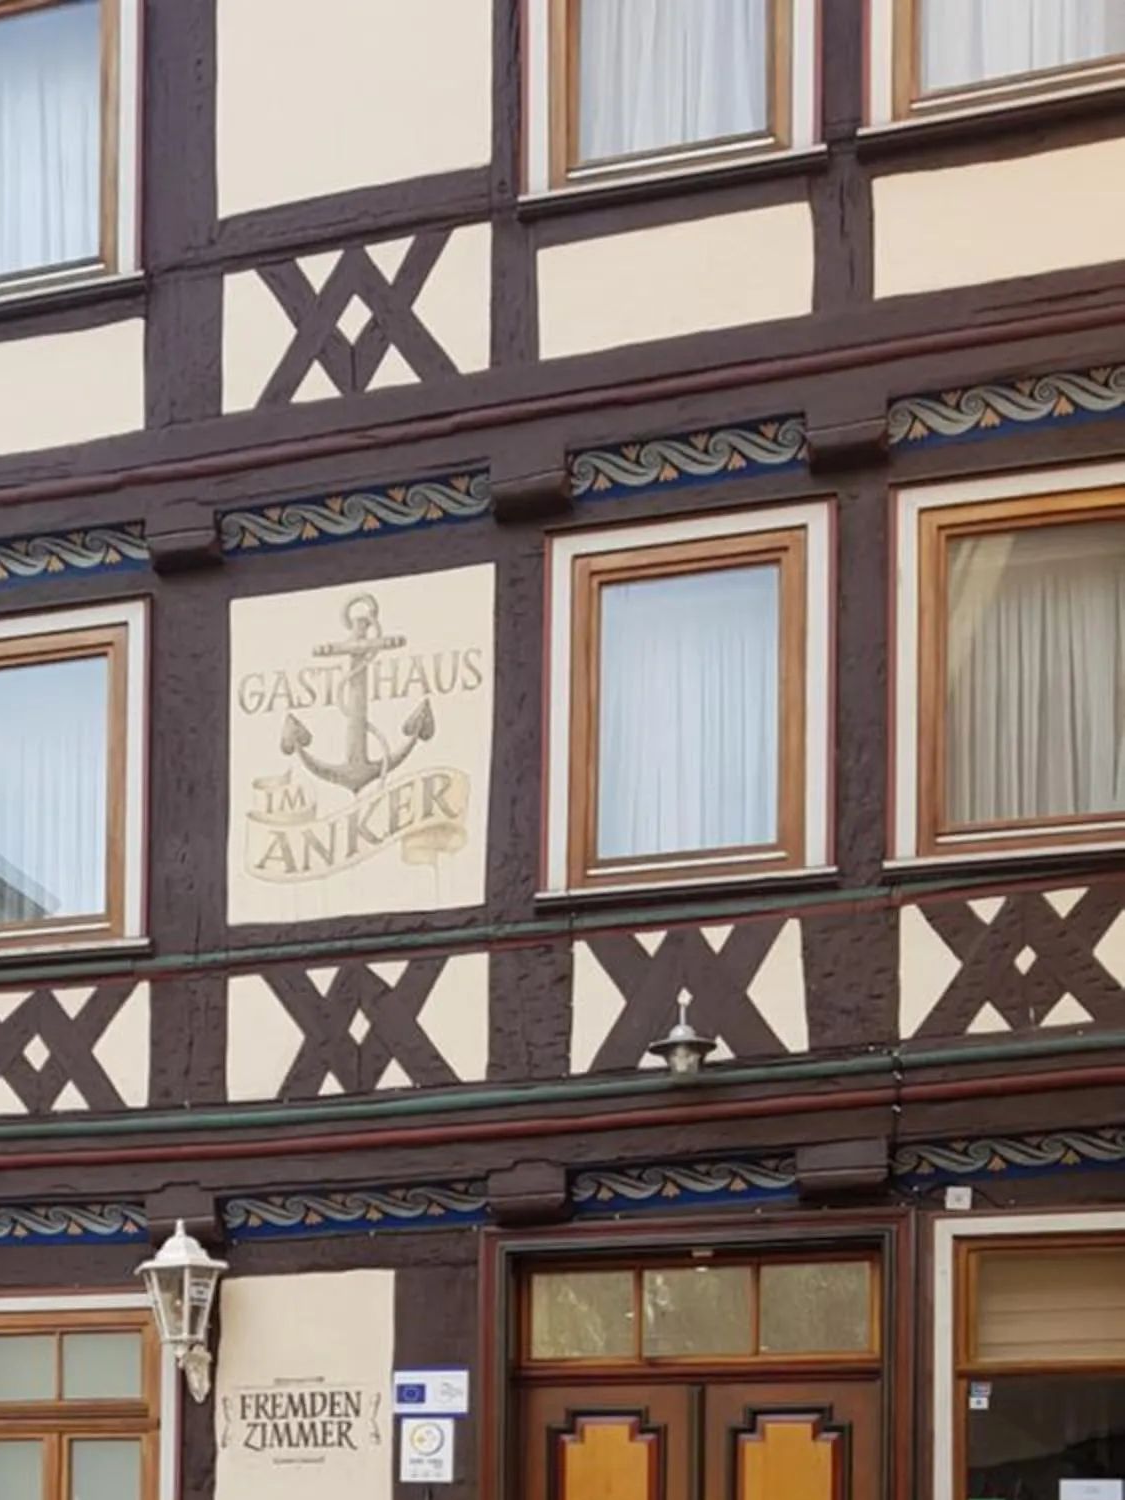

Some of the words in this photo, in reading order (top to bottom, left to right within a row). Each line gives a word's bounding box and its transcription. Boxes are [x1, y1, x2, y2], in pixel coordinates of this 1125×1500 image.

[265, 787, 307, 815] IM
[255, 773, 460, 874] ANKER
[239, 1391, 363, 1421] FREMDEN
[243, 1420, 358, 1452] ZIMMER
